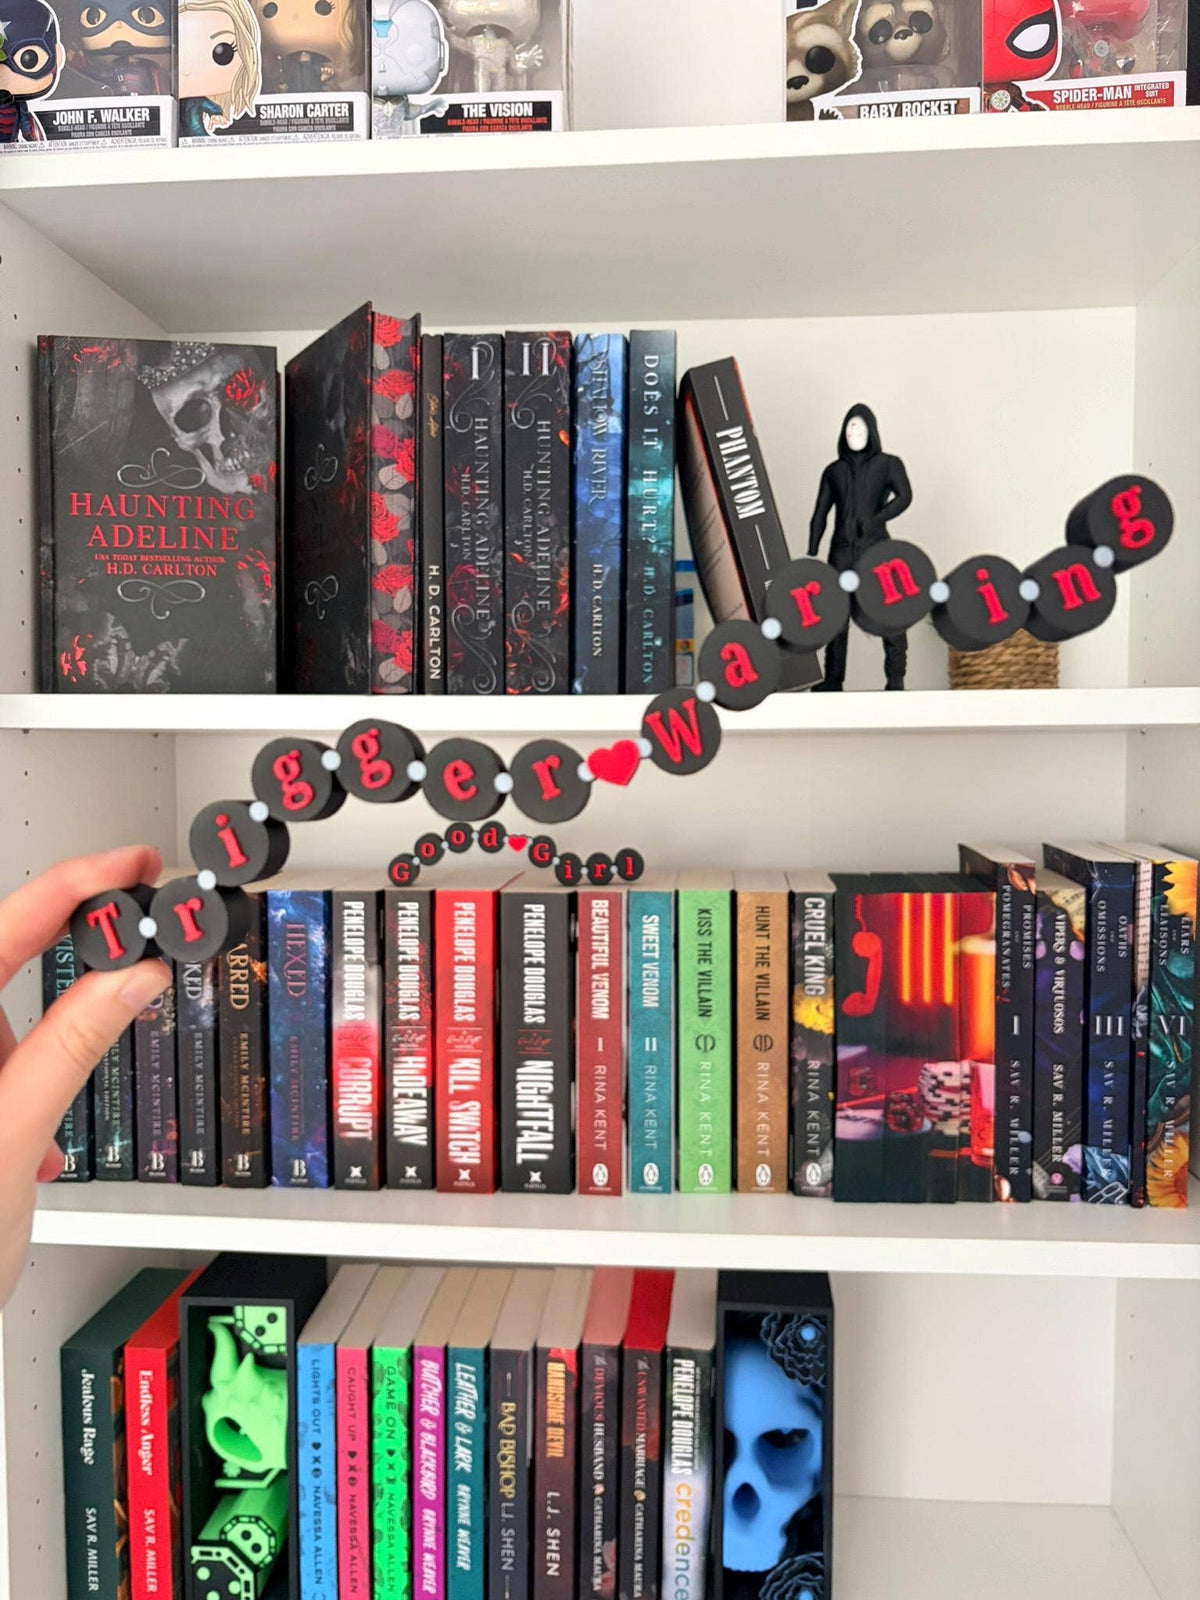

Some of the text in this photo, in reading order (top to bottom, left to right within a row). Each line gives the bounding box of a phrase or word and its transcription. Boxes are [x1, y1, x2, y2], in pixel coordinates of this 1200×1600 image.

[53, 108, 150, 125] JOHN F. WALKER
[260, 103, 349, 119] SHARON CARTER
[462, 103, 532, 117] THE VISION
[860, 100, 958, 118] BABY ROCKET
[1053, 86, 1132, 103] SPIDER-MAN
[1134, 83, 1169, 91] INTEGRATED
[588, 354, 607, 505] SHALLOW RIVER
[643, 354, 660, 544] DOES IT HURT?
[716, 425, 765, 519] PHANTOM
[70, 492, 255, 520] HAUNTING
[87, 525, 238, 551] ADELINE
[461, 501, 471, 560] CARLTON
[474, 418, 489, 620] HAUNTING ADELINE
[522, 498, 532, 557] CARLTON
[536, 420, 551, 611] HUNTING ADELINE
[106, 563, 217, 576] H.D. CARLTON
[429, 565, 441, 679] H. D. CARLTON
[593, 580, 603, 657] D. CARLTON
[642, 608, 655, 684] CARLTON
[86, 484, 1155, 960] Trigger Warning
[391, 827, 634, 882] Good Girl
[284, 923, 306, 998] HEXED
[398, 902, 419, 962] PENELOPE
[454, 902, 475, 962] PENELOPE
[524, 904, 545, 964] PENELOPE
[591, 900, 609, 1019] BEAUTIFUL VENOM
[642, 915, 659, 1007] SWEET VENOM
[698, 908, 712, 1017] KISS THE VILLAIN
[755, 906, 769, 1020] HUNT THE VILLAIN
[804, 897, 826, 995] CRUEL KING
[1002, 885, 1011, 988] POMEGRANATES
[1022, 904, 1032, 969] PROMISES
[1052, 913, 1066, 1034] VIPERS VIRTUOSOS
[1096, 900, 1106, 972] OMISSIONS
[1118, 916, 1127, 958] OATHS
[1159, 904, 1167, 966] LIAISONS
[1181, 917, 1189, 954] LIARS
[337, 901, 372, 1141] PENELOPE DOUGLAS CORRUPT
[398, 965, 420, 1020] DOUGLAS
[454, 965, 475, 1021] DOUGLAS
[524, 967, 545, 1023] DOUGLAS
[111, 1067, 121, 1126] MCINTIRE
[151, 1030, 161, 1136] EMILY MCINTIRE
[194, 1032, 205, 1135] EMILY MCINTIRE
[240, 1033, 251, 1136] EMILY MCINTIRE
[289, 1036, 300, 1141] EMILY MCINTIRE
[392, 1056, 427, 1146] HIDEAWAY
[448, 1058, 480, 1093] KILL
[516, 1061, 553, 1164] NIGHTFALL
[595, 1065, 606, 1150] RINA KENT
[646, 1065, 657, 1149] RINA KENT
[699, 1062, 711, 1156] RINA KENT
[758, 1062, 769, 1157] RINA KENT
[807, 1060, 820, 1156] RINA KENT
[1009, 1060, 1020, 1176] SAV R. MILLER
[1052, 1064, 1063, 1162] SAV R. MILLER
[448, 1101, 480, 1164] SWITCH
[1102, 1061, 1114, 1178] SAV R. MILLER
[1163, 1061, 1176, 1179] SAV MILLER
[80, 1369, 96, 1465] Jealous Rage
[138, 1369, 154, 1475] Endless Anger
[312, 1359, 321, 1434] LIGHTS OUT
[348, 1368, 356, 1441] CAUGHT UP
[386, 1365, 396, 1440] GAME ON
[420, 1360, 442, 1500] BUTCHER & BLACKBIRD
[455, 1363, 478, 1474] LEATHER & LARK
[547, 1362, 565, 1458] HANDSOME DEVIL
[593, 1368, 604, 1479] DEVIOUS HUSBAND
[635, 1371, 645, 1488] UNWANTED MARRIAGE
[671, 1359, 695, 1475] PENELOPE DOUGLAS
[497, 1402, 515, 1499] BAD BISHOP
[86, 1508, 98, 1591] SAV R. MILLER
[144, 1509, 157, 1592] SAV R. MILLER
[313, 1486, 323, 1584] NAVESSA ALLEN
[349, 1494, 358, 1593] NAVESSA ALLEN
[387, 1493, 395, 1549] NAVESSA
[422, 1508, 436, 1594] BRYNNE WEAVER
[456, 1484, 471, 1571] BRYNNE WEAVER
[501, 1528, 514, 1570] SHEN
[546, 1492, 560, 1576] L.J. SHEN
[674, 1483, 695, 1600] credence
